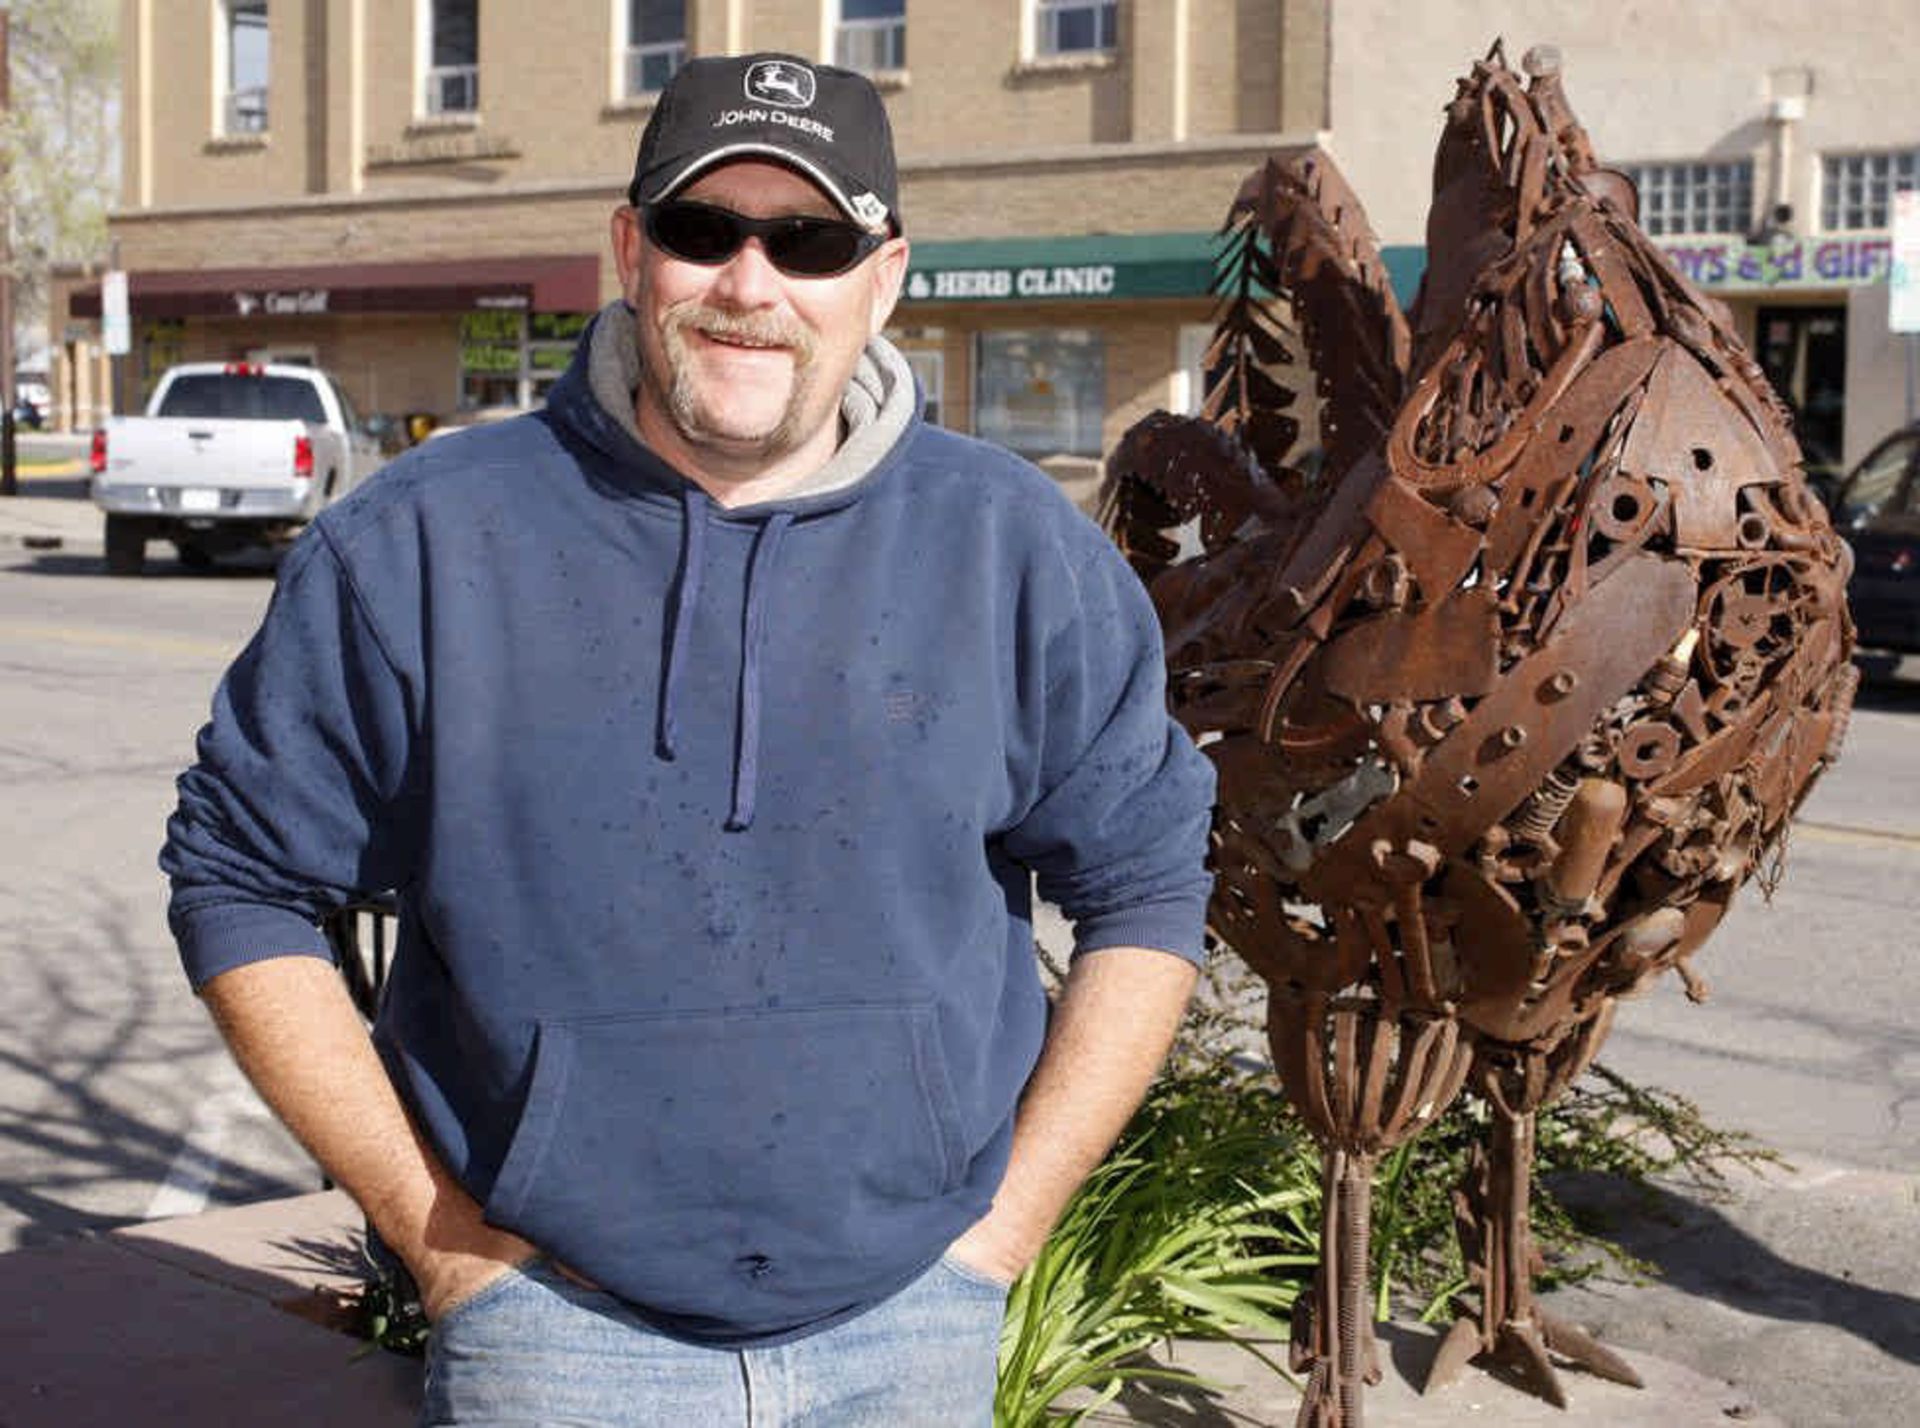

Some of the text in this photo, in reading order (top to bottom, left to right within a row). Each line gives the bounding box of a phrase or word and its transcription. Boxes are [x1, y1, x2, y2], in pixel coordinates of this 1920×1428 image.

[712, 109, 835, 142] JOHN DEERE
[1736, 240, 1802, 281] ad
[934, 269, 1011, 297] HERB
[1016, 265, 1115, 296] CLINIC
